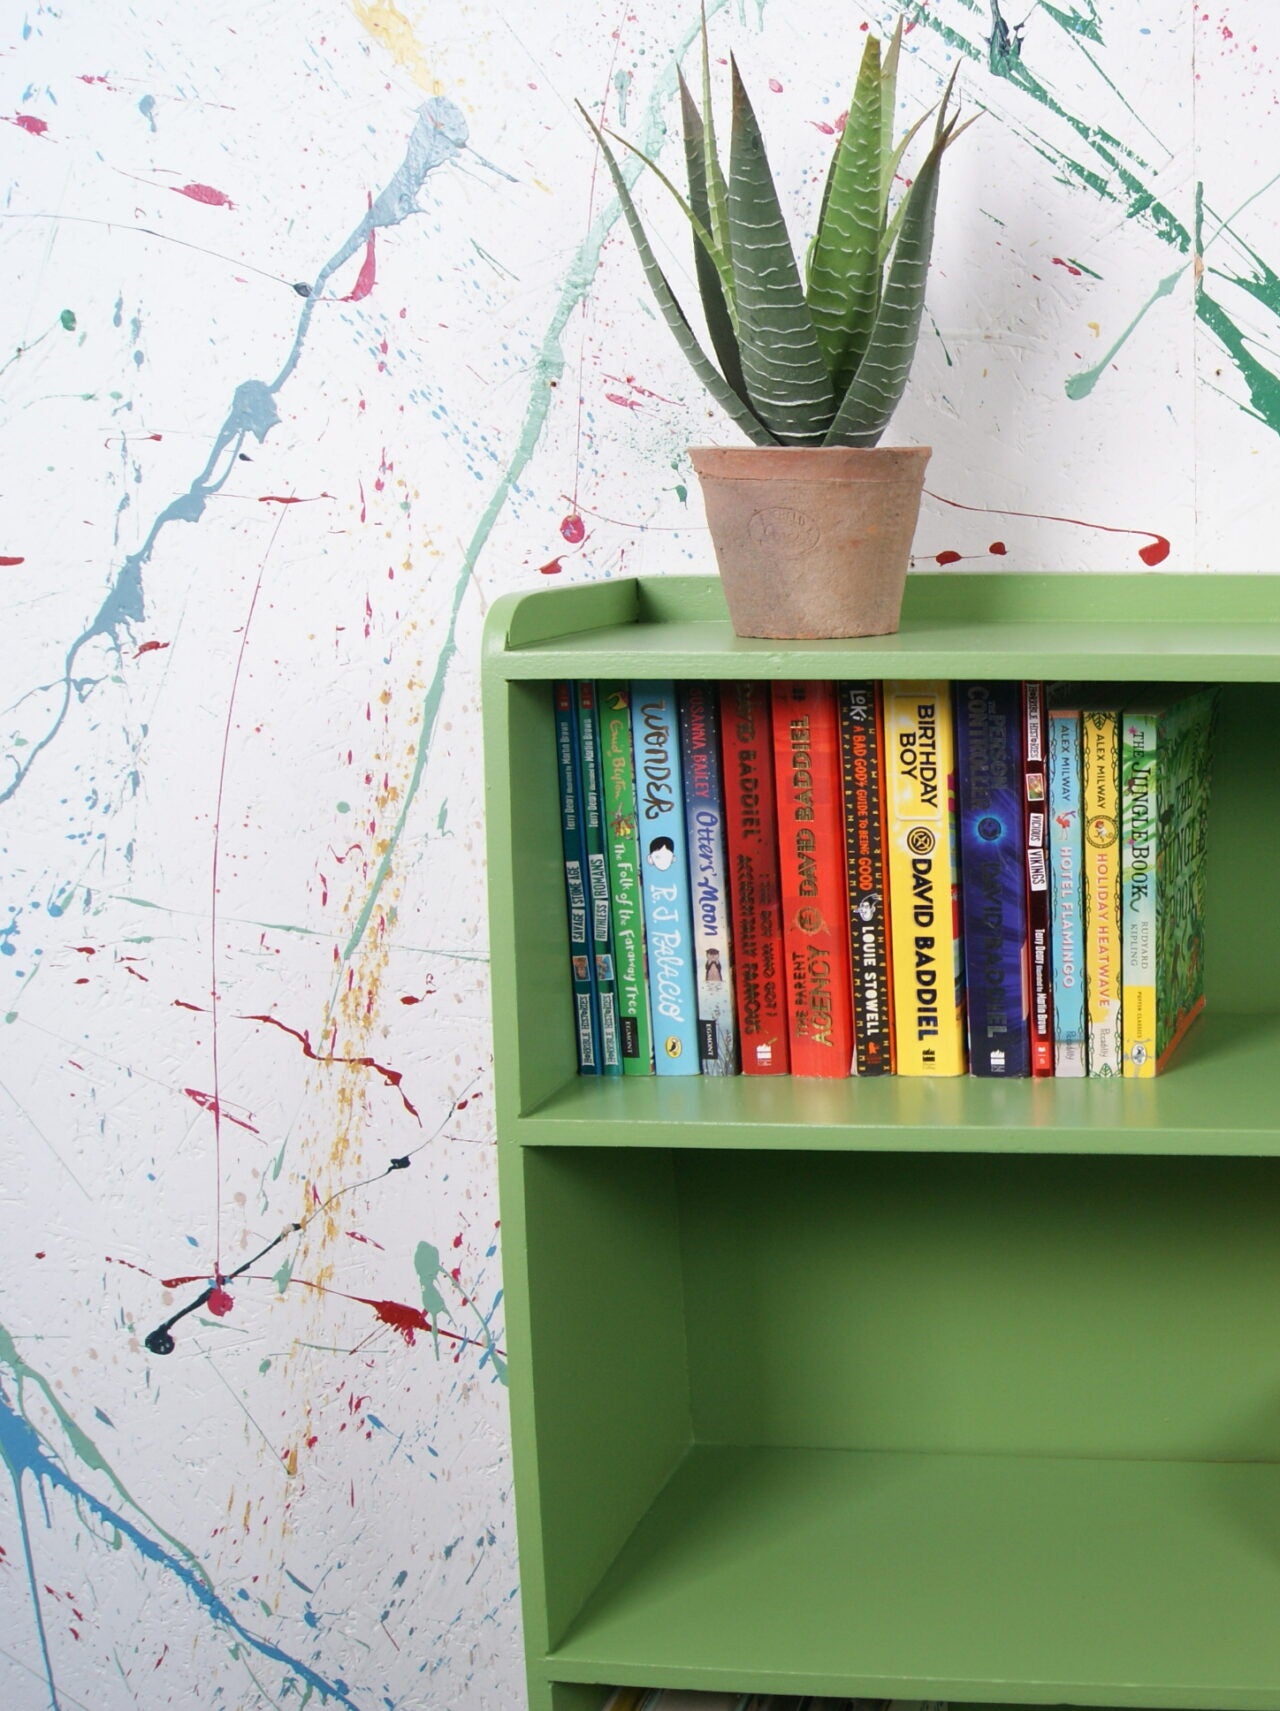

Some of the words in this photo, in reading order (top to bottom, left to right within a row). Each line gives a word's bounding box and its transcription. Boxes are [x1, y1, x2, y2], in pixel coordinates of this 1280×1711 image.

[736, 683, 756, 744] DAVID
[1028, 684, 1039, 721] HORRIBLE
[582, 719, 592, 741] Brown
[853, 725, 865, 734] A
[853, 735, 867, 756] BAD
[1060, 725, 1070, 753] ALEX
[1132, 731, 1145, 758] THE
[561, 741, 570, 765] Martin
[584, 741, 594, 762] Martin
[900, 732, 918, 781] BOY
[916, 704, 938, 808] BIRTHDAY
[968, 686, 993, 811] CONTROLLER
[991, 714, 1009, 791] PERSON
[1096, 734, 1105, 762] ALEX
[611, 757, 627, 801] Blyton
[692, 754, 710, 798] BAILEY
[789, 714, 815, 823] BADDIEL
[1061, 757, 1071, 802] MILWAY
[565, 793, 575, 813] Deary
[587, 792, 598, 812] Deary
[737, 750, 761, 838] BADDIEL
[856, 790, 869, 817] GUIDE
[1096, 766, 1106, 809] MILWAY
[1131, 761, 1152, 842] JUNGLE
[566, 814, 576, 830] Terry
[588, 812, 598, 828] Terry
[1031, 815, 1041, 842] VICIOUS
[613, 843, 626, 860] The
[858, 829, 870, 857] BEING
[568, 865, 580, 880] AGE
[590, 858, 607, 896] ROMANS
[617, 863, 634, 890] Folk
[795, 828, 818, 896] DAVID
[858, 857, 873, 891] GOOD
[1029, 850, 1045, 885] VIKINGS
[1060, 846, 1073, 898] HOTEL
[1130, 846, 1150, 912] BOOK
[569, 883, 584, 905] STONE
[615, 893, 633, 906] of
[650, 884, 678, 904] R.
[912, 858, 935, 928] DAVID
[983, 862, 1003, 930] DAVID
[1097, 853, 1109, 921] HOLIDAY
[595, 904, 607, 939] RUTHLESS
[618, 909, 634, 926] the
[651, 907, 679, 924] J.
[697, 877, 719, 936] Moon
[737, 853, 757, 958] ACCIDENTALLY
[573, 914, 584, 940] SAVAGE
[760, 911, 773, 937] BOY
[1034, 929, 1046, 945] Terry
[618, 930, 637, 986] Faraway
[761, 942, 775, 979] WHO
[861, 926, 877, 967] LOUIE
[1035, 946, 1046, 964] Deary
[1061, 902, 1076, 989] FLAMINGO
[1130, 924, 1138, 966] KIPLING
[1141, 921, 1149, 969] RUDYARD
[792, 952, 807, 1006] PARENT
[1097, 925, 1110, 1007] HEATWAVE
[626, 985, 640, 1015] Tree
[742, 963, 761, 1035] FAMOUS
[807, 945, 834, 1047] AGENCY
[863, 972, 880, 1036] STOWELL
[914, 936, 939, 1041] BADDIEL
[984, 937, 1008, 1038] BADDIEL
[1037, 993, 1047, 1014] Martin
[624, 1021, 633, 1053] EGMONT
[705, 1023, 714, 1055] EGMONT
[795, 1011, 810, 1037] THE
[1038, 1014, 1046, 1034] Brown
